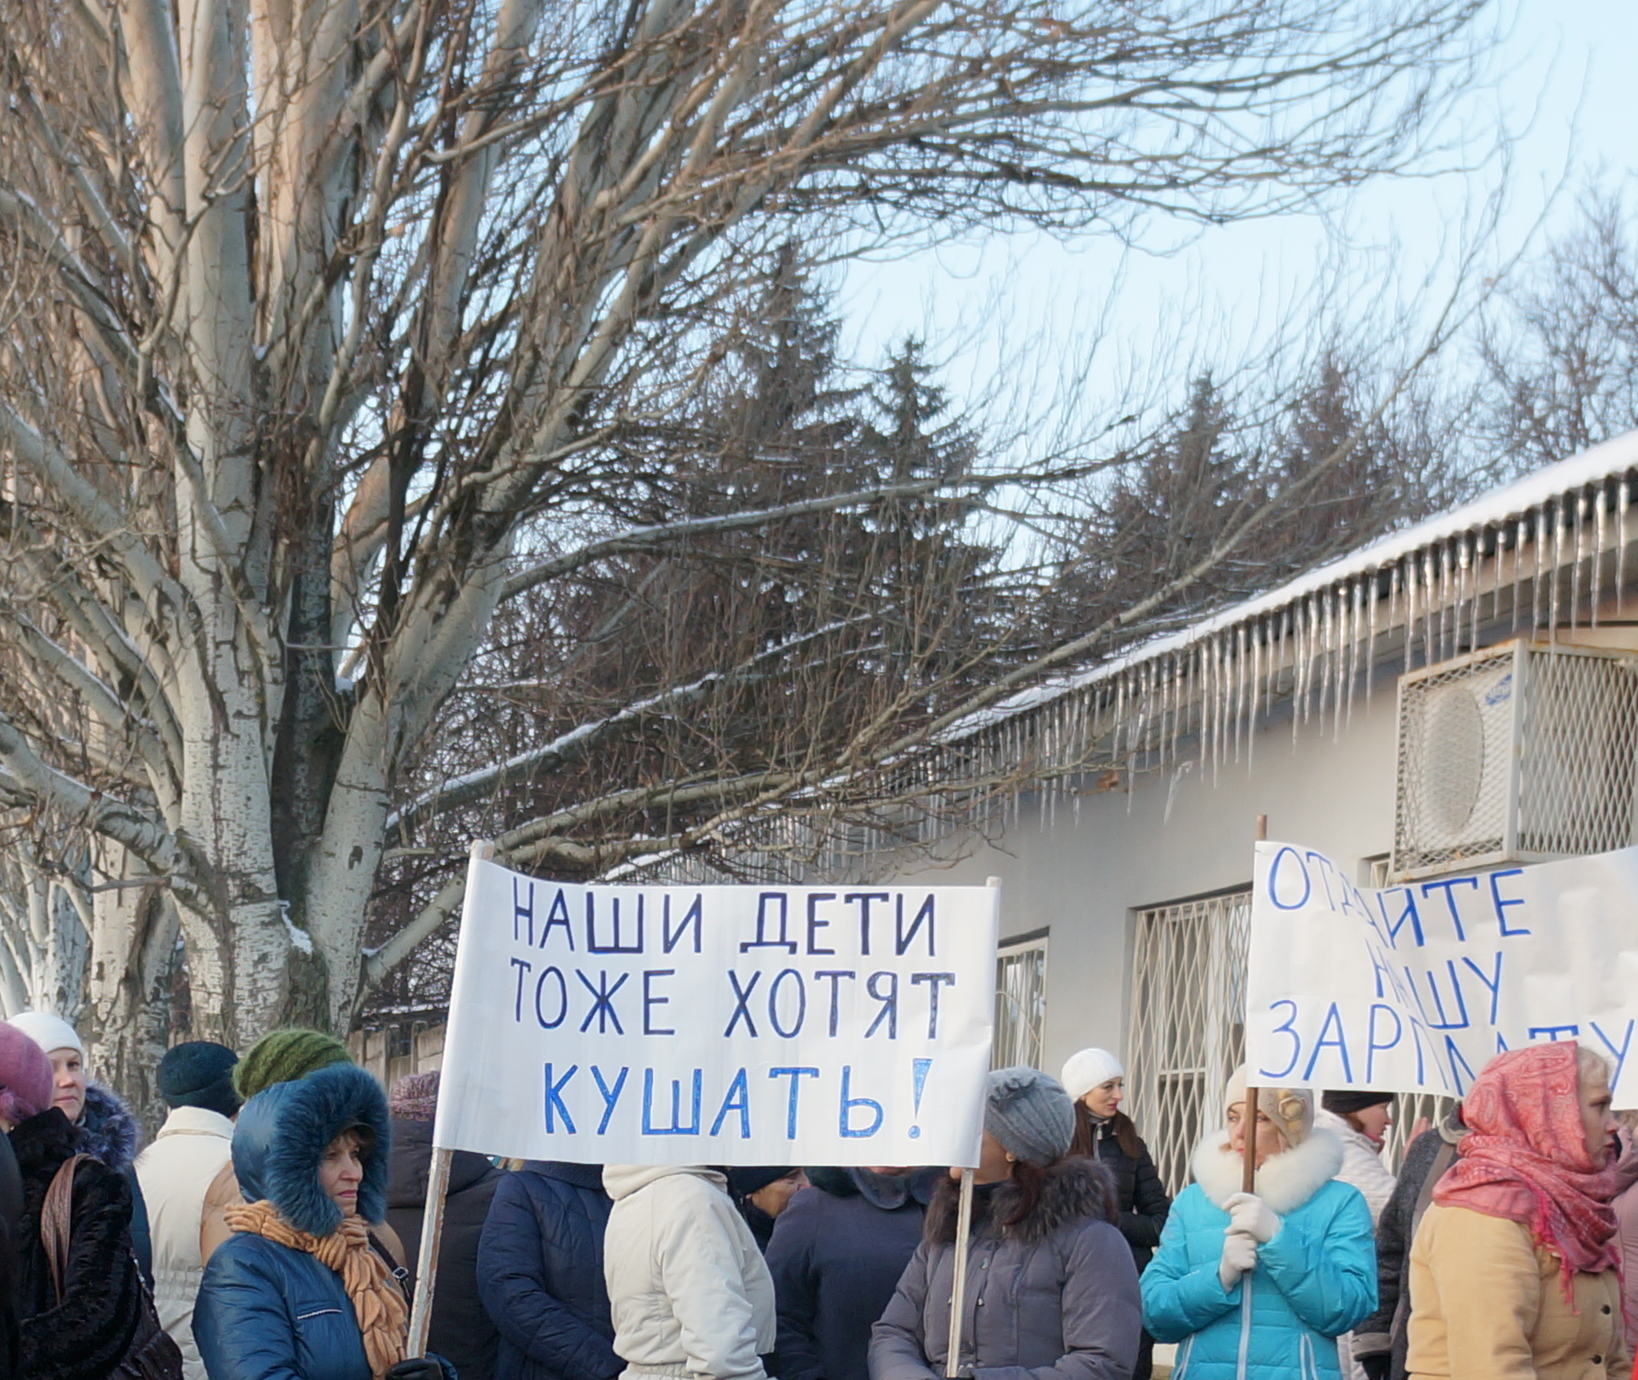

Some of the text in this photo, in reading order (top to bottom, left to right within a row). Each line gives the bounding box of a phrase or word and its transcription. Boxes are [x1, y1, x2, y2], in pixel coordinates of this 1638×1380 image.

[512, 875, 937, 957] НАШИ ДЕТИ
[1267, 846, 1532, 950] ОТДАЙТЕ
[509, 957, 956, 1040] ТОЖЕ ХОТЯТ
[1364, 937, 1504, 1030] НАШУ
[543, 1056, 933, 1141] КУШАТЬ!
